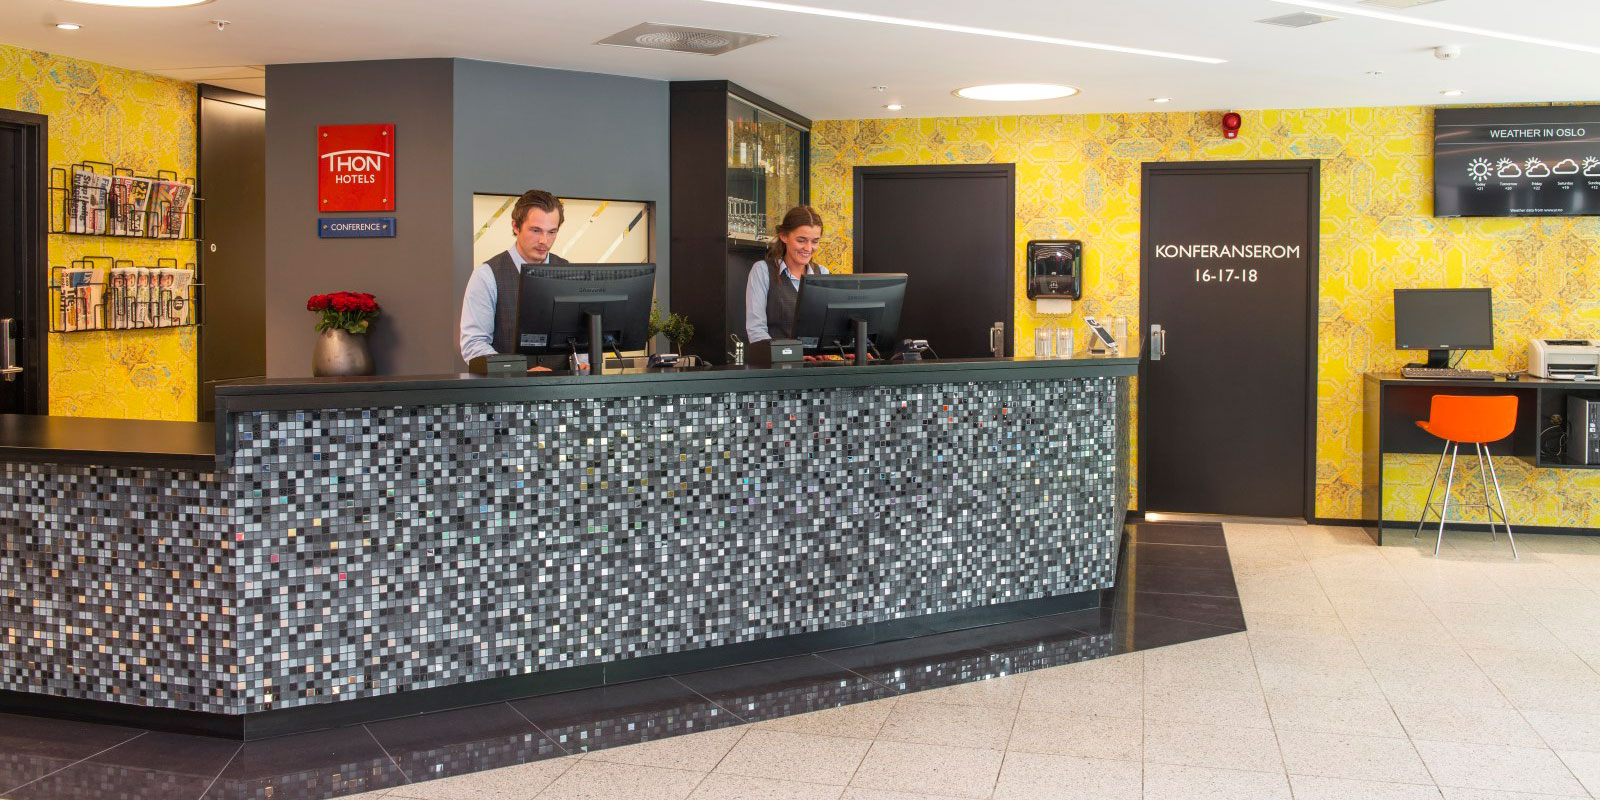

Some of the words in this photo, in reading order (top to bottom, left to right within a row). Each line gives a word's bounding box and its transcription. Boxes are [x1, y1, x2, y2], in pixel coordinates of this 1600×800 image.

[1489, 128, 1541, 138] WEATHER
[1543, 128, 1554, 137] IN
[1556, 128, 1586, 137] OSLO
[321, 149, 390, 172] THON
[335, 174, 376, 184] HOTELS
[330, 223, 381, 231] CONFERENCE
[1155, 244, 1300, 259] KONFERANSEROM
[1195, 268, 1258, 283] 16-17-18
